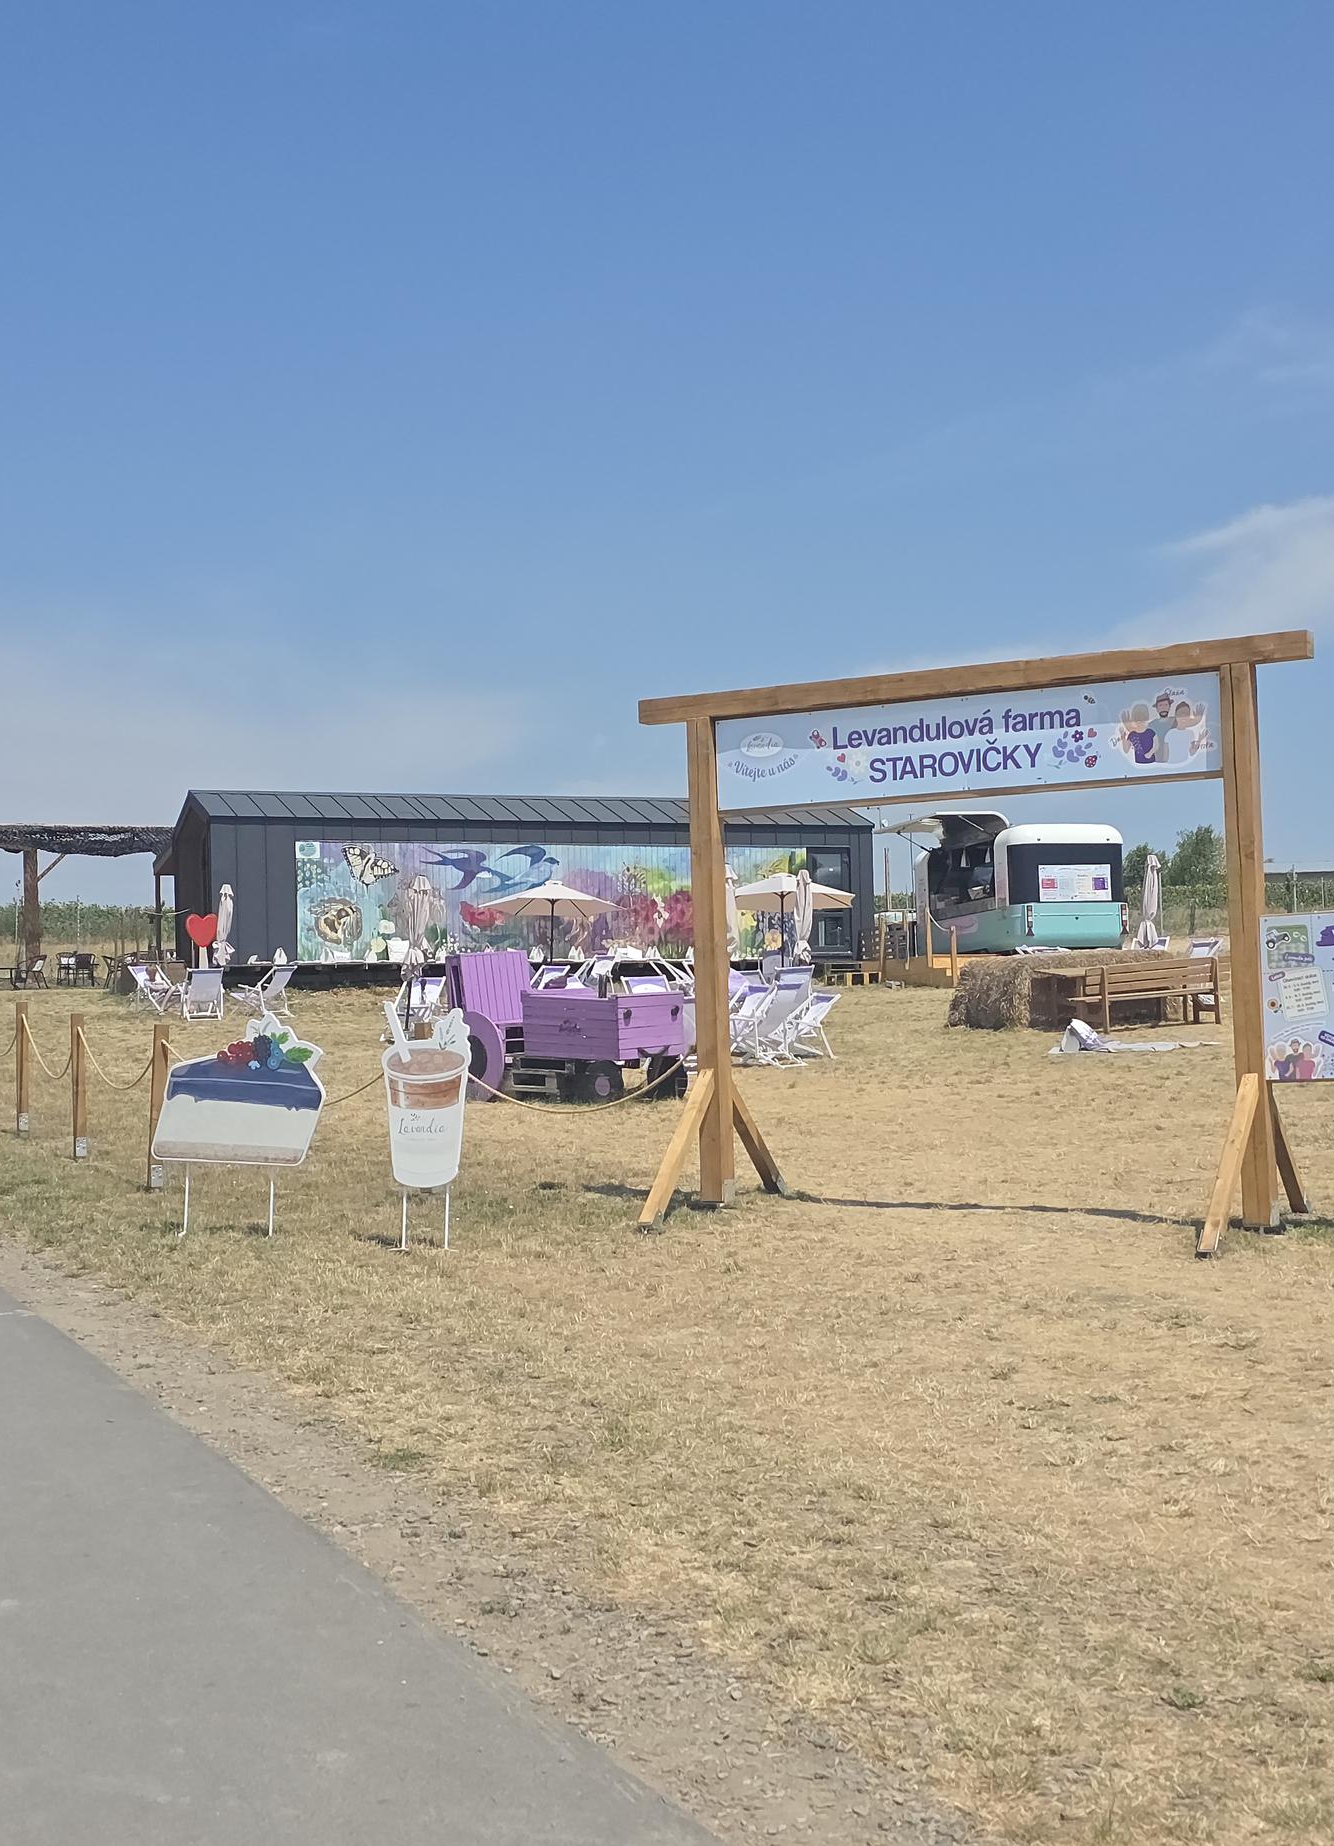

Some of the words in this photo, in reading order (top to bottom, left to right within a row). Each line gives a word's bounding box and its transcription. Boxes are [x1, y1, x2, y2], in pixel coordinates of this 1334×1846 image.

[832, 708, 994, 750] Levandulová
[1002, 707, 1082, 733] farma
[734, 760, 767, 782] Vítejte
[768, 768, 776, 777] u
[777, 757, 796, 773] nás
[869, 737, 1043, 783] STAROVIČKY
